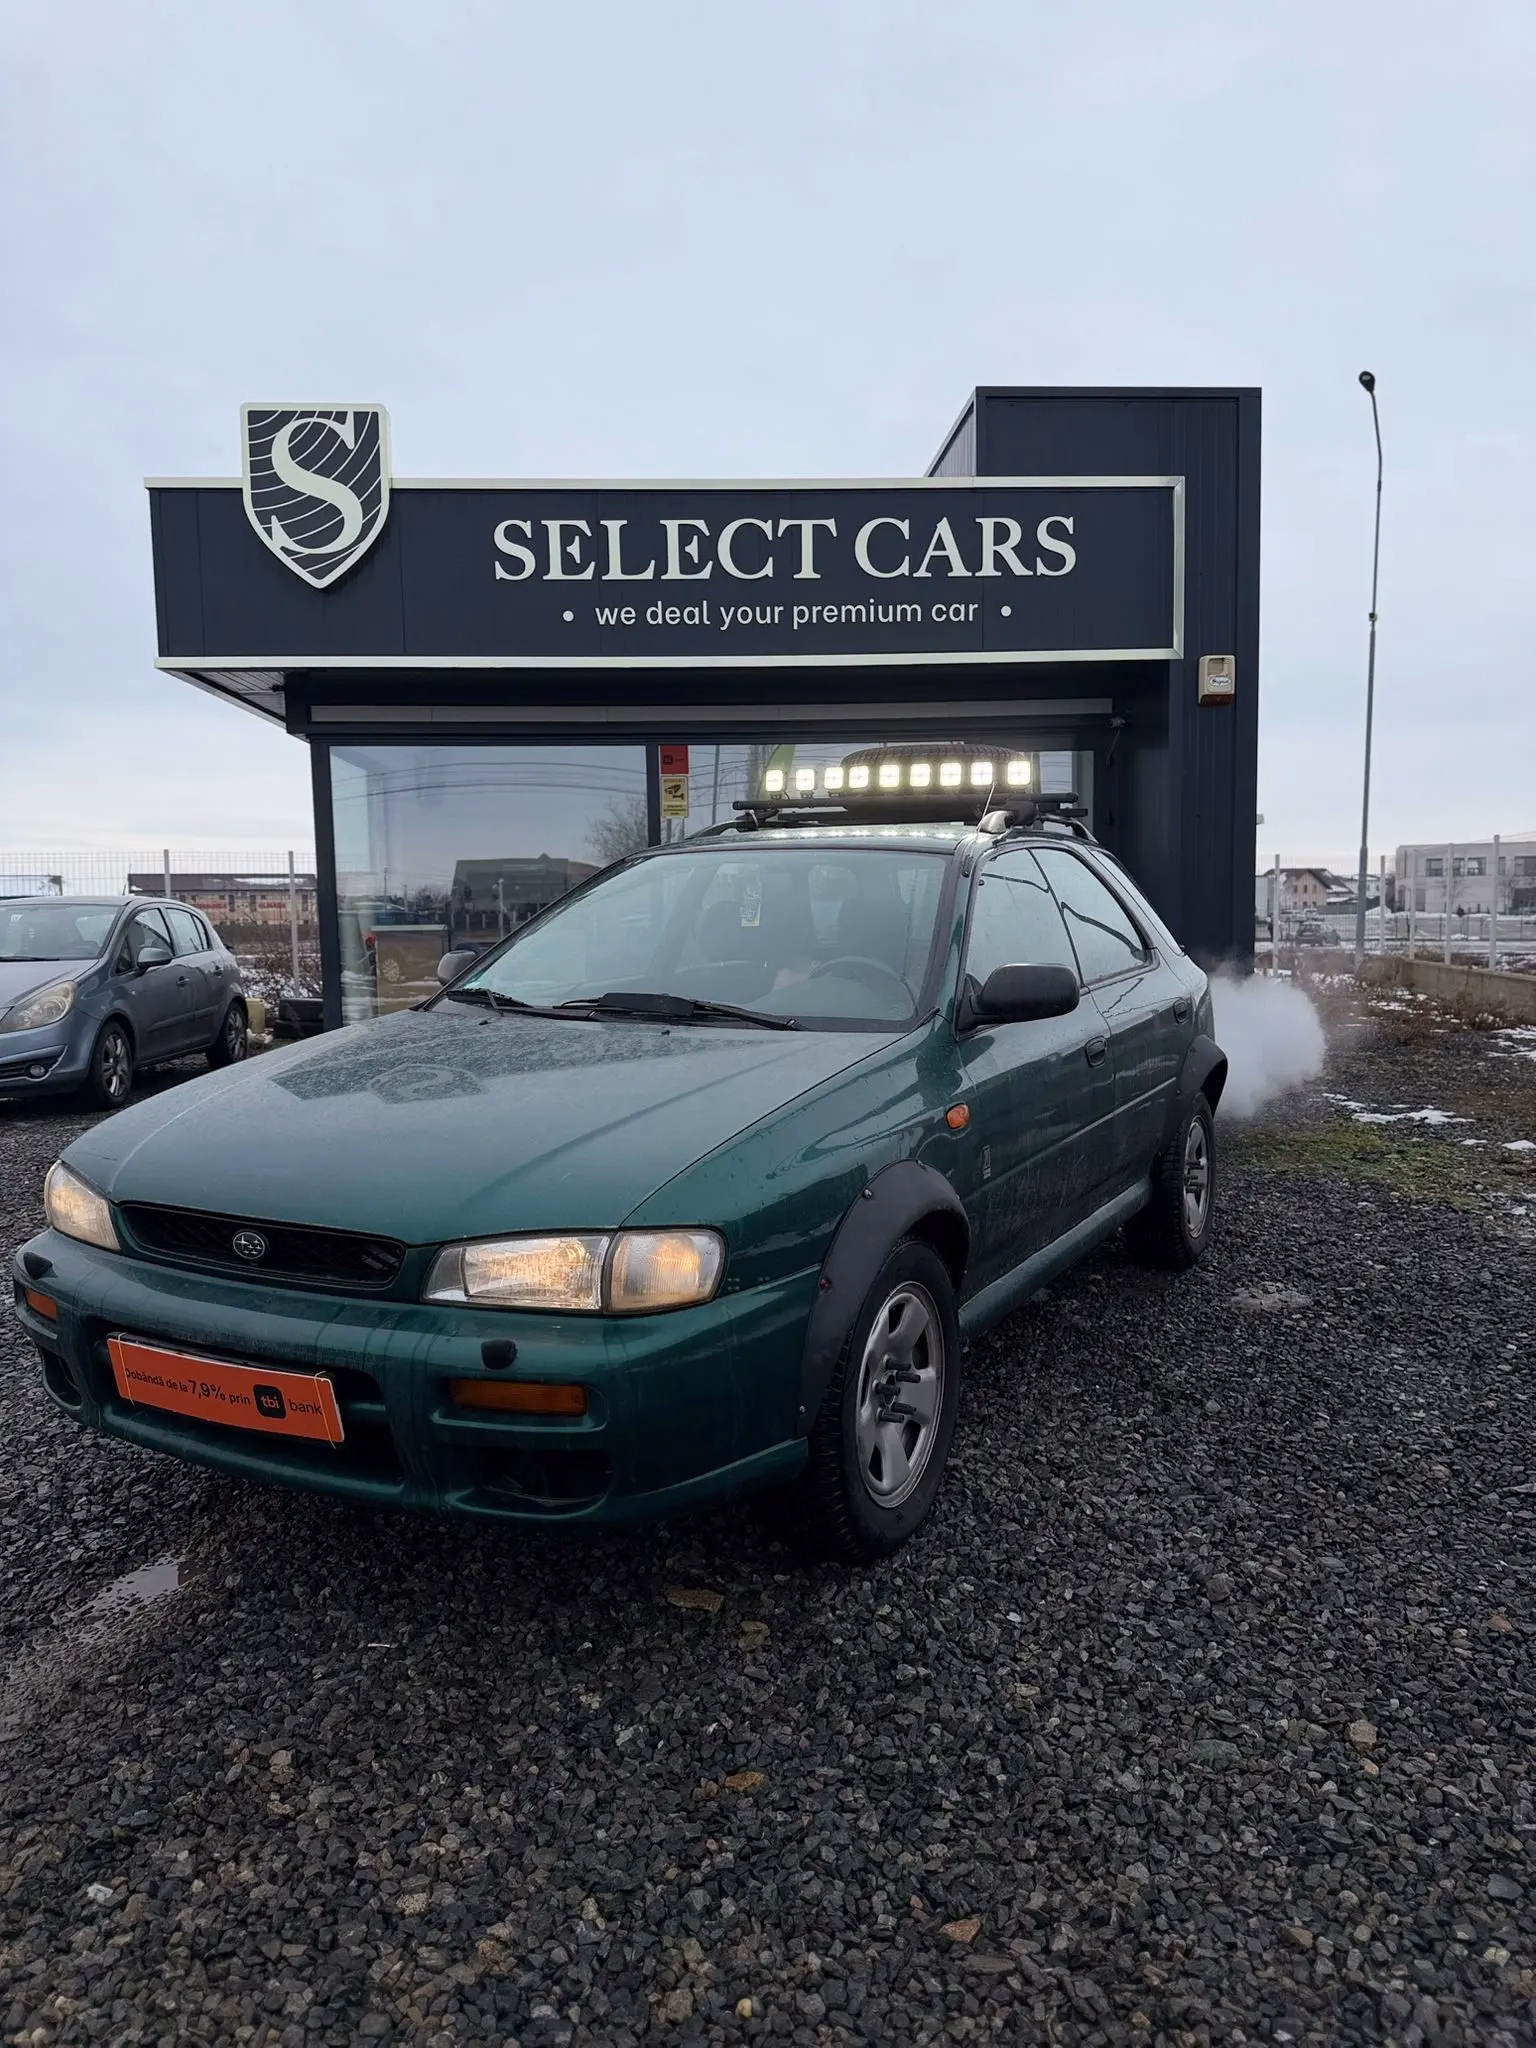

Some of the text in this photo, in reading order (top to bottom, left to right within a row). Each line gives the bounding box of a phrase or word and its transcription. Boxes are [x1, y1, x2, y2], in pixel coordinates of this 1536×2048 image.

[271, 411, 363, 554] S
[493, 515, 1077, 581] SELECT CARS
[595, 597, 979, 631] we deal your premium car
[166, 1378, 178, 1391] de
[179, 1380, 189, 1393] la
[188, 1379, 226, 1400] 7,9%
[229, 1392, 251, 1406] prin
[261, 1395, 280, 1409] tbi
[288, 1399, 323, 1415] bank
